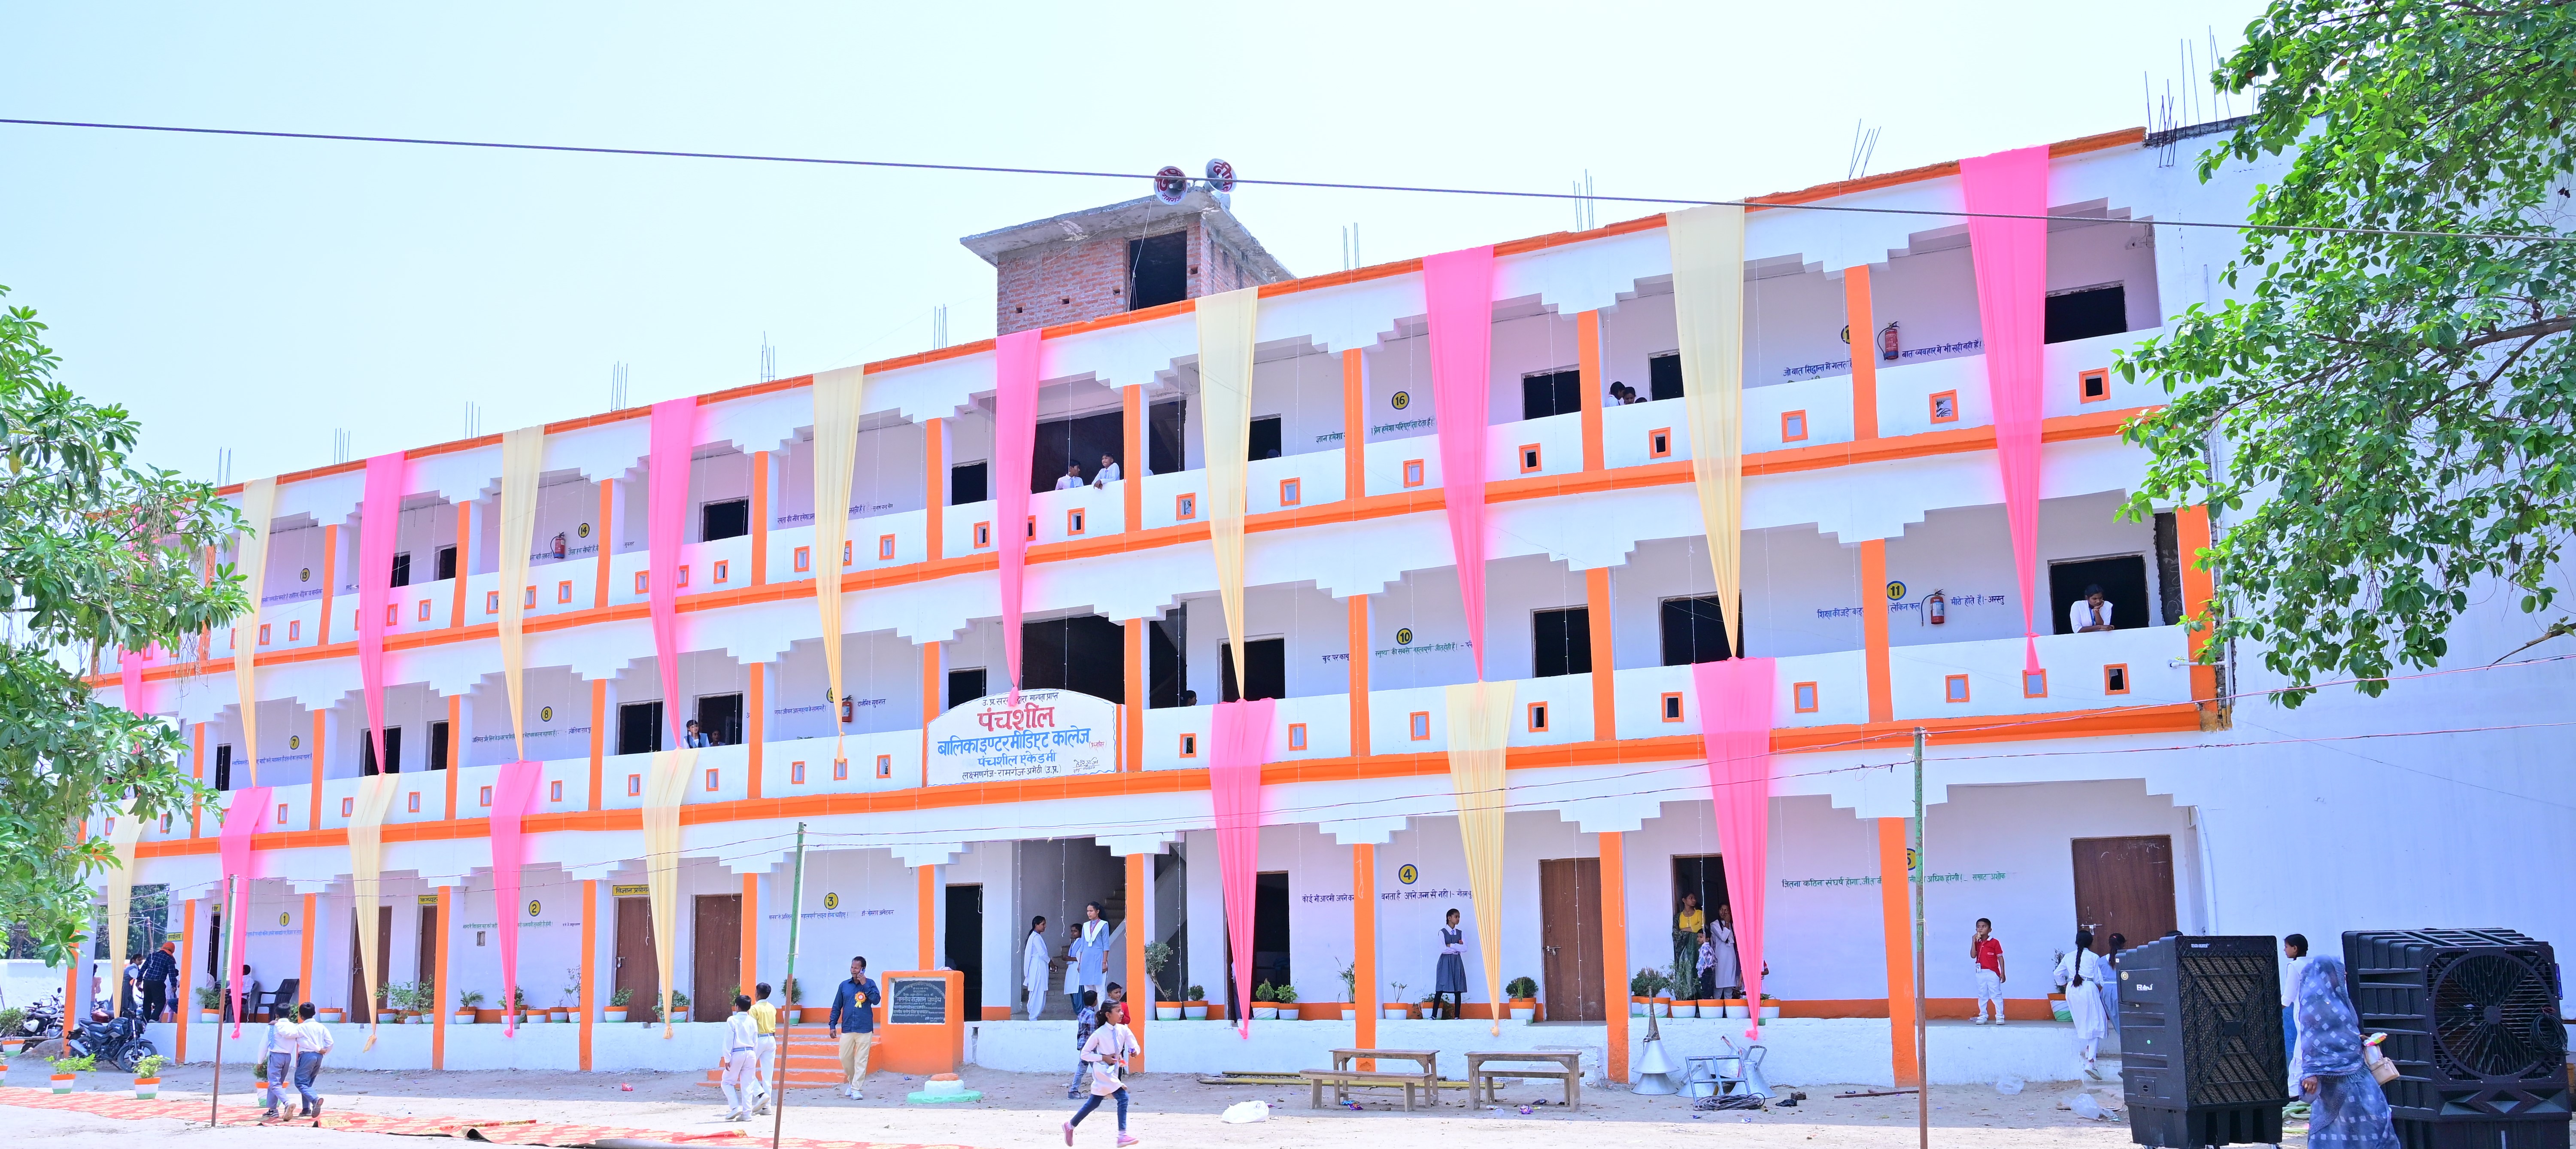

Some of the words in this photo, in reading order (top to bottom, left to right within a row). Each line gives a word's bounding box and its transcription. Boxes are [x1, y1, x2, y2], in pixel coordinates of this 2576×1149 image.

[1396, 395, 1405, 406] 16
[1381, 423, 1395, 434] हमेशा
[1418, 419, 1426, 428] देता
[1315, 435, 1328, 444] ज्ञान
[1328, 432, 1344, 443] हमेशा
[580, 525, 587, 535] 14
[302, 571, 307, 579] 13
[1890, 585, 1900, 596] 11
[1889, 602, 1908, 613] लेकिन
[1908, 603, 1921, 612] फल
[1817, 609, 1832, 620] शिक्षा
[1400, 632, 1410, 642] 10
[1029, 693, 1045, 702] मान्यता
[1047, 692, 1059, 701] प्राप्त
[977, 702, 1055, 732] पंचशील
[938, 735, 979, 757] बालिका
[1052, 725, 1092, 748] कालेज
[978, 752, 1017, 768] पंचशील
[1020, 750, 1057, 766] एकेडमी
[1403, 869, 1412, 880] 4
[1802, 878, 1824, 888] कठिन
[1302, 894, 1313, 903] कोई
[1314, 894, 1320, 903] भी
[1336, 893, 1348, 902] अपने
[1396, 889, 1402, 901] है
[1405, 890, 1417, 900] अपने
[828, 897, 833, 906] 3
[531, 904, 536, 913] 2
